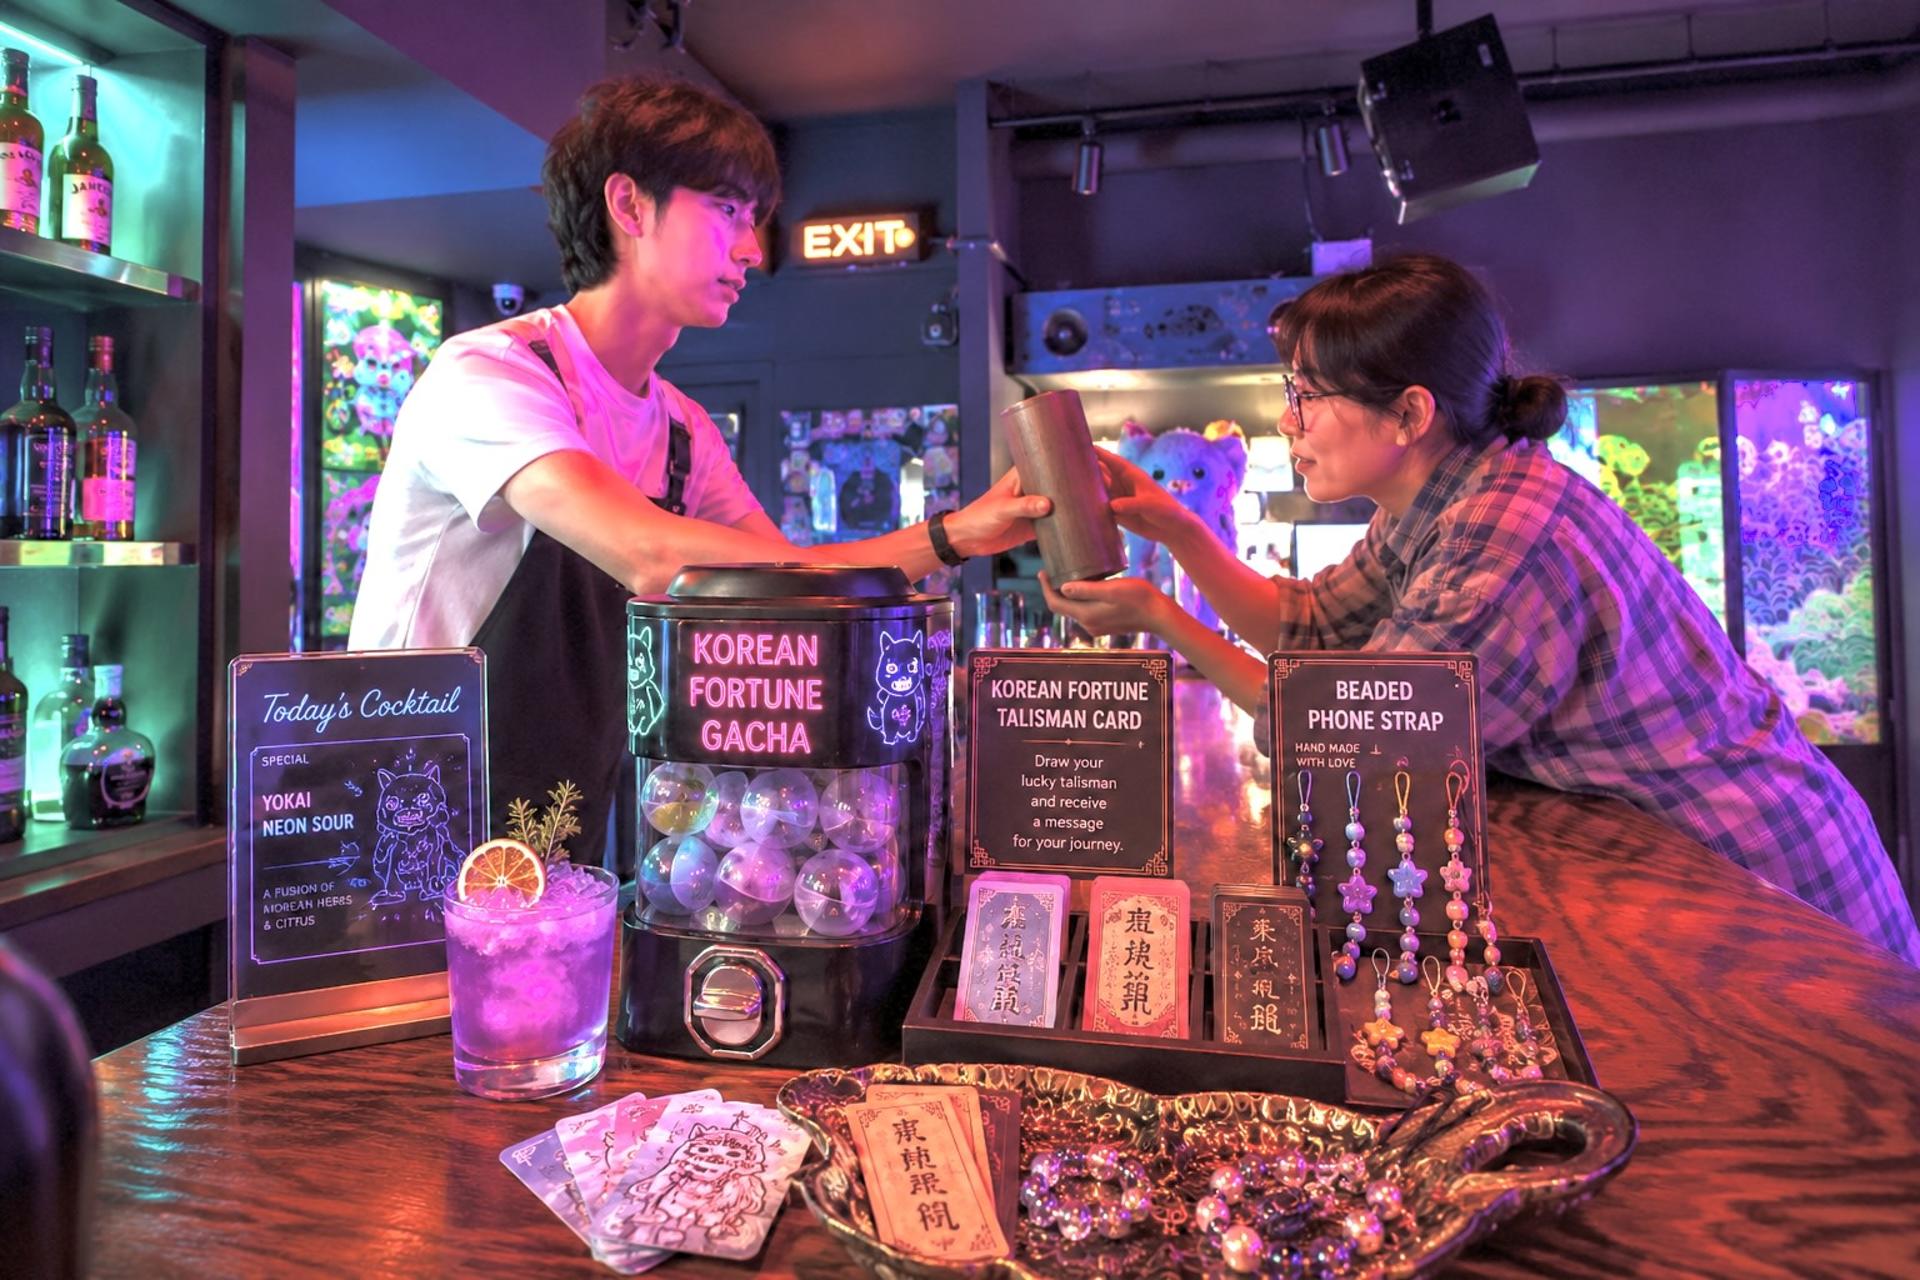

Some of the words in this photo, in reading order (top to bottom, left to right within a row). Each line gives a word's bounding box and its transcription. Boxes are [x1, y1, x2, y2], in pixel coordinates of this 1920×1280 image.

[804, 219, 905, 259] EXIT
[693, 632, 818, 667] KOREAN
[689, 677, 823, 711] FORTUNE
[991, 679, 1062, 700] KOREAN
[1067, 681, 1149, 701] FORTUNE
[1336, 680, 1414, 701] BEADED
[263, 692, 352, 733] Today's
[360, 686, 461, 718] Cocktail
[997, 708, 1086, 729] TALISMAN
[1092, 710, 1142, 730] CARD
[1308, 709, 1375, 730] PHONE
[1380, 711, 1444, 732] STRAP
[701, 720, 812, 755] GACHA
[1295, 742, 1326, 753] HAND
[262, 753, 309, 767] SPECIAL
[1035, 755, 1070, 768] Draw
[1073, 758, 1104, 771] your
[1296, 757, 1325, 768] WITH
[1328, 758, 1356, 768] LOVE
[1021, 774, 1056, 791] lucky
[1060, 776, 1117, 790] talisman
[262, 791, 311, 812] YOKAI
[1031, 795, 1056, 808] and
[1059, 796, 1107, 810] receive
[263, 817, 307, 837] NEON
[312, 813, 354, 832] SOUR
[1033, 817, 1041, 828] a
[1045, 817, 1104, 832] message
[1013, 834, 1032, 848] for
[1035, 838, 1067, 851] your
[1068, 836, 1124, 854] journey.
[263, 889, 272, 900] A
[275, 884, 317, 898] FUSION
[320, 881, 335, 893] OF
